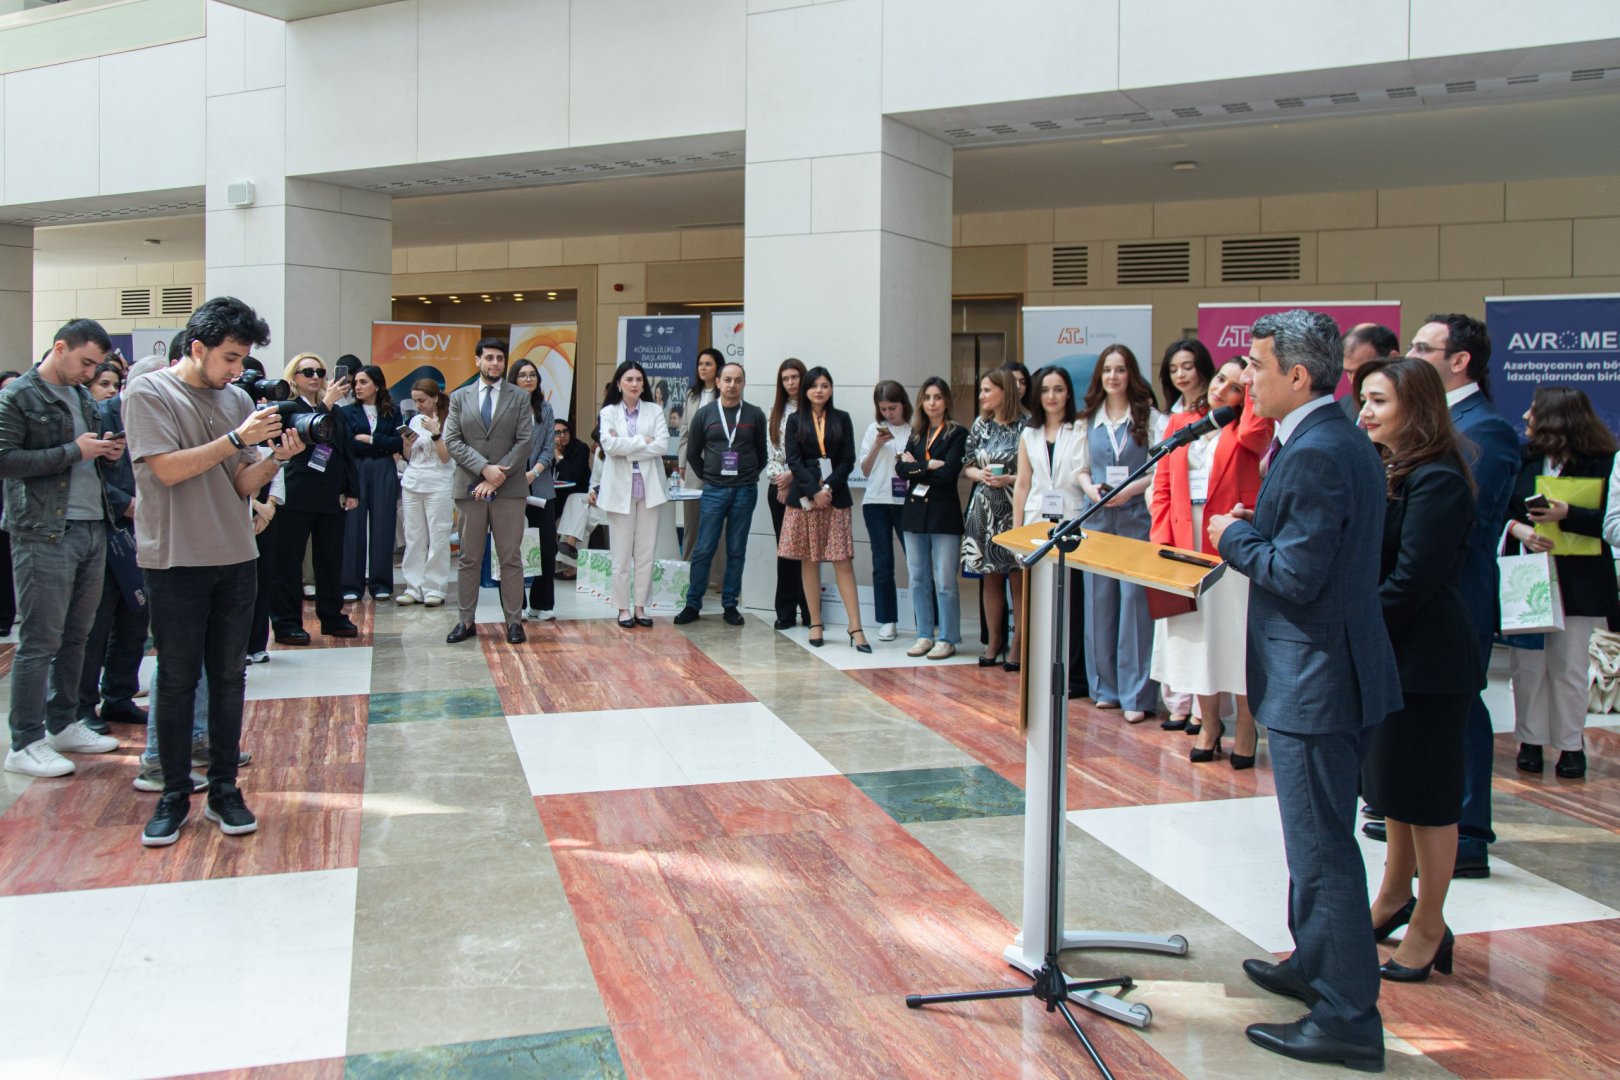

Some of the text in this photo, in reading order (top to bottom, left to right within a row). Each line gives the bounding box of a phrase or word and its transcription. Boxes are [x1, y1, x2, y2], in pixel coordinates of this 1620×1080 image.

[404, 330, 452, 351] abv
[1504, 361, 1583, 372] Azərbaycanın
[1586, 362, 1600, 370] ən
